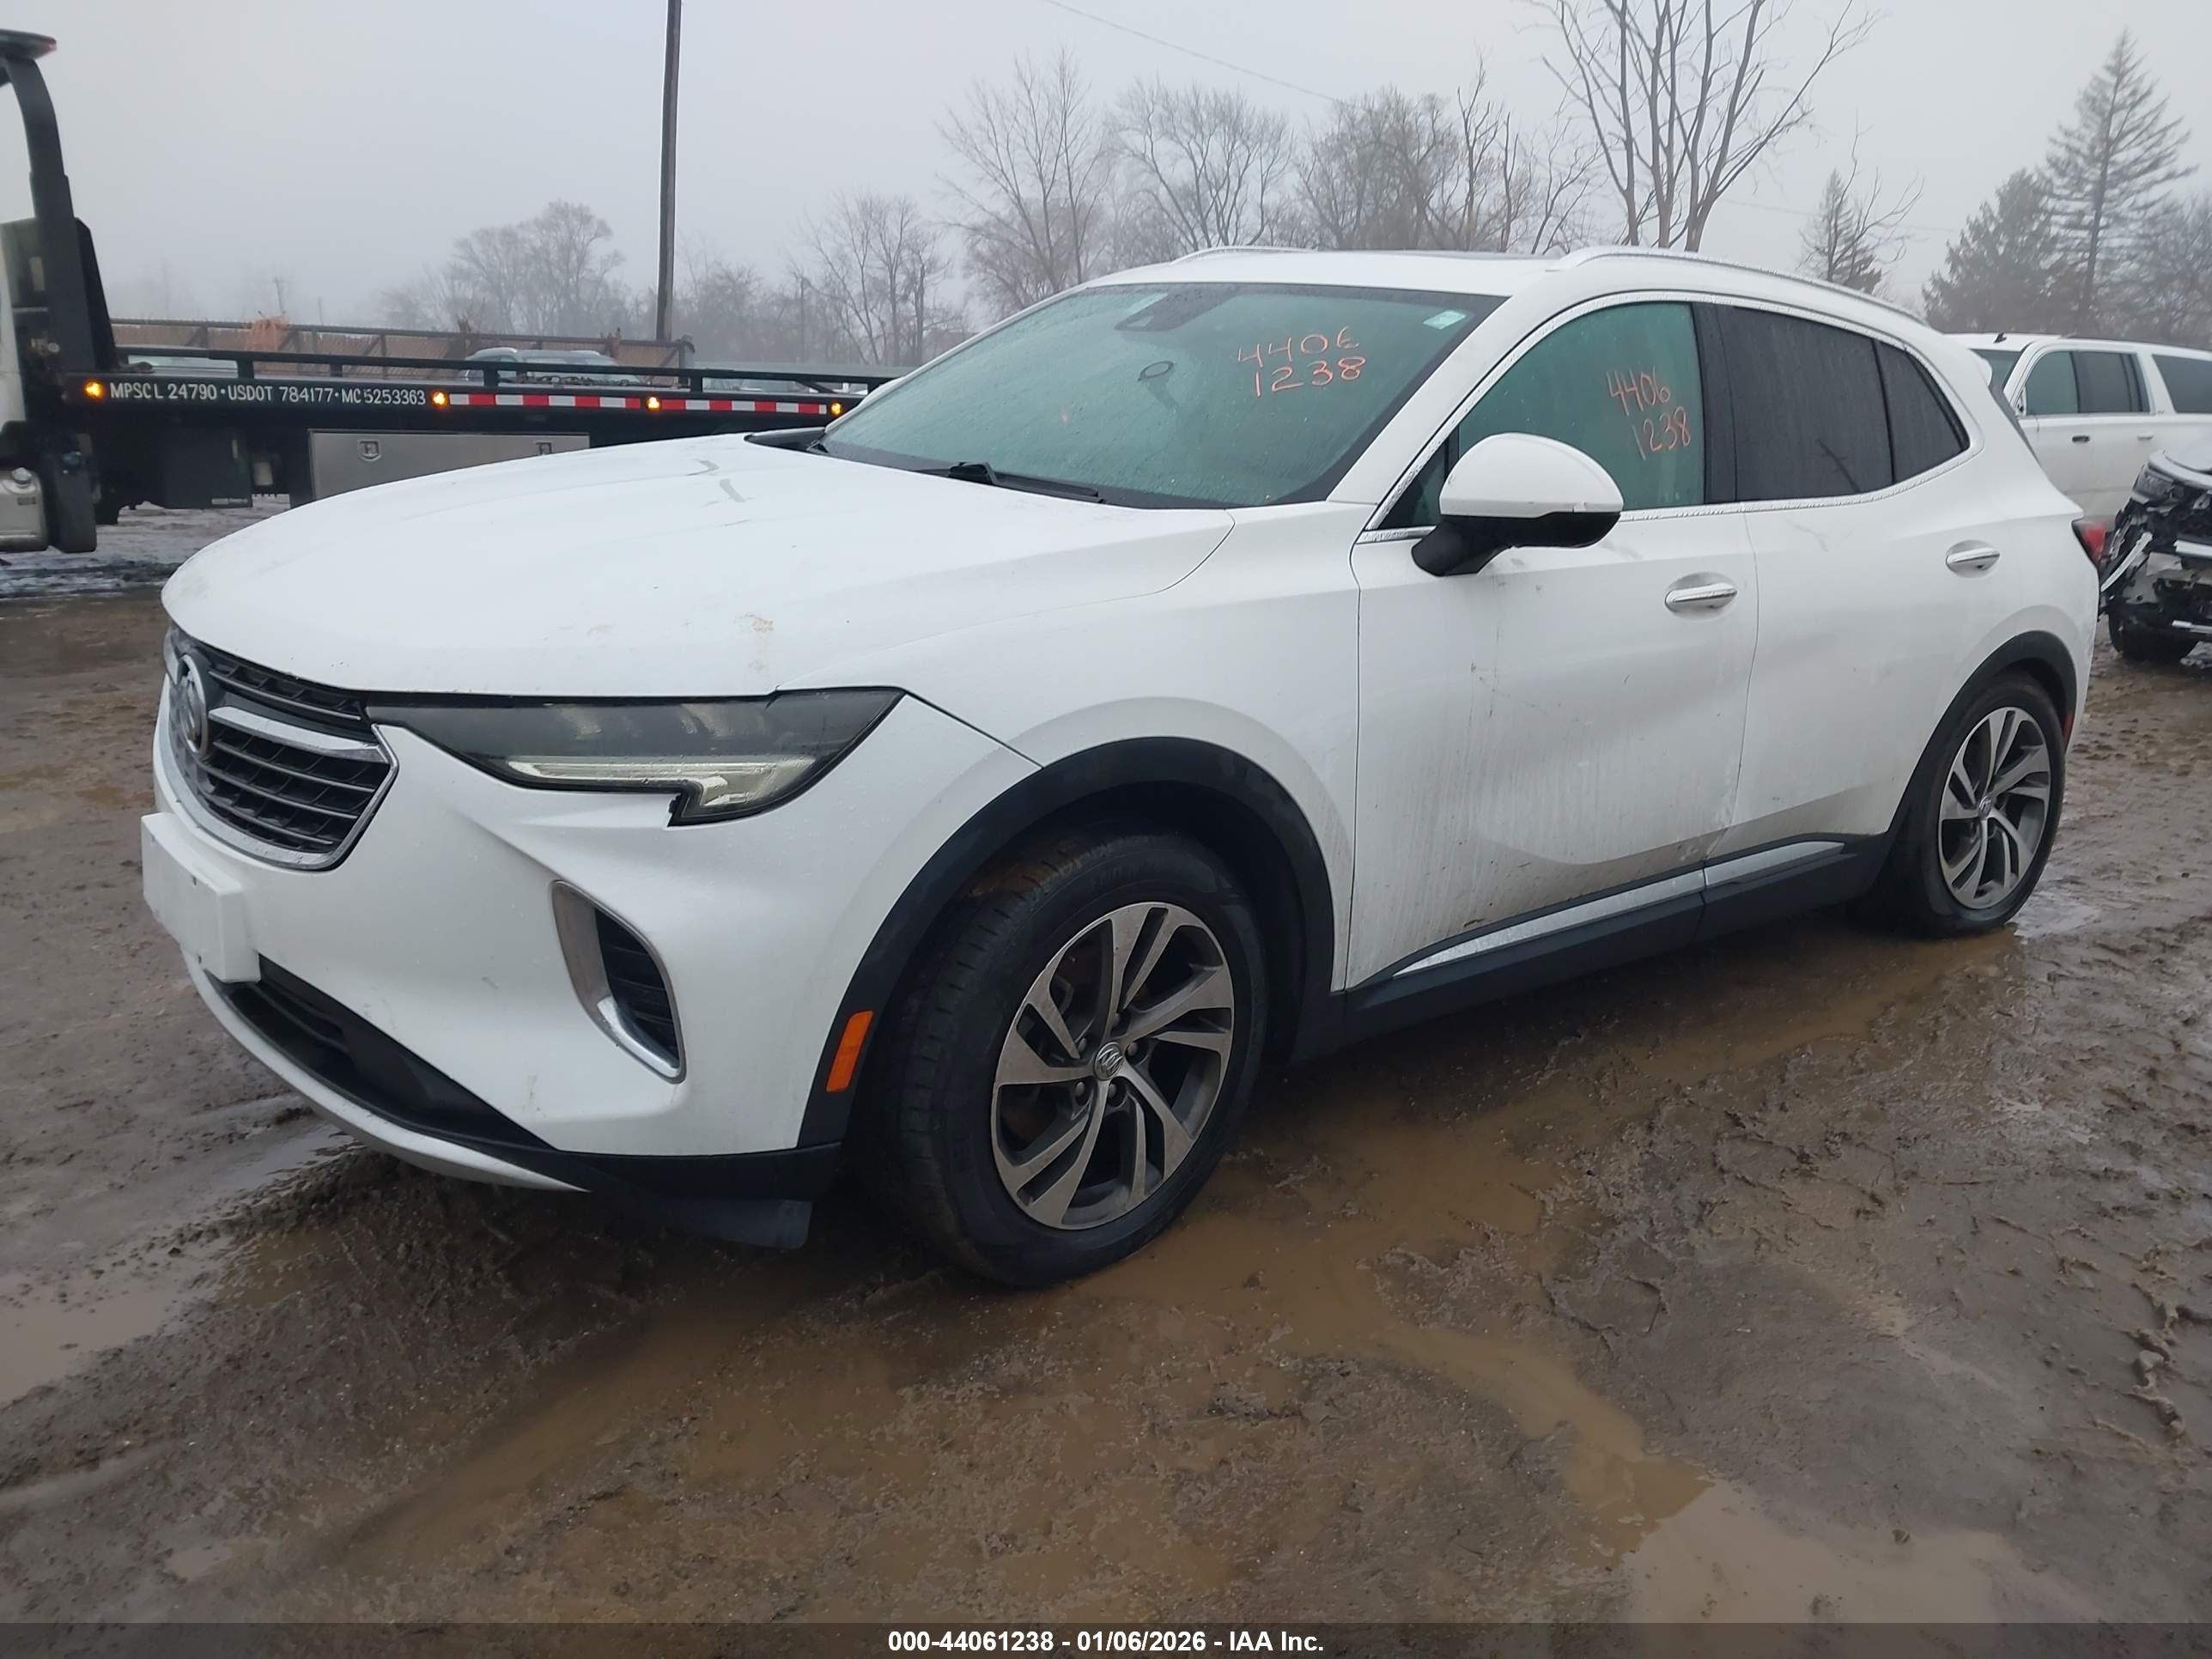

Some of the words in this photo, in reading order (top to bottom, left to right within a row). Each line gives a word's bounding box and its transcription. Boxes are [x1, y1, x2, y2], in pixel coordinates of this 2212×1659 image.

[1237, 325, 1360, 368] 4406
[167, 383, 217, 401] 24790
[227, 384, 273, 402] USDOT
[278, 386, 334, 403] 784177
[1255, 356, 1366, 398] 1238
[1605, 364, 1671, 417] 4406
[1632, 405, 1691, 461] 1238
